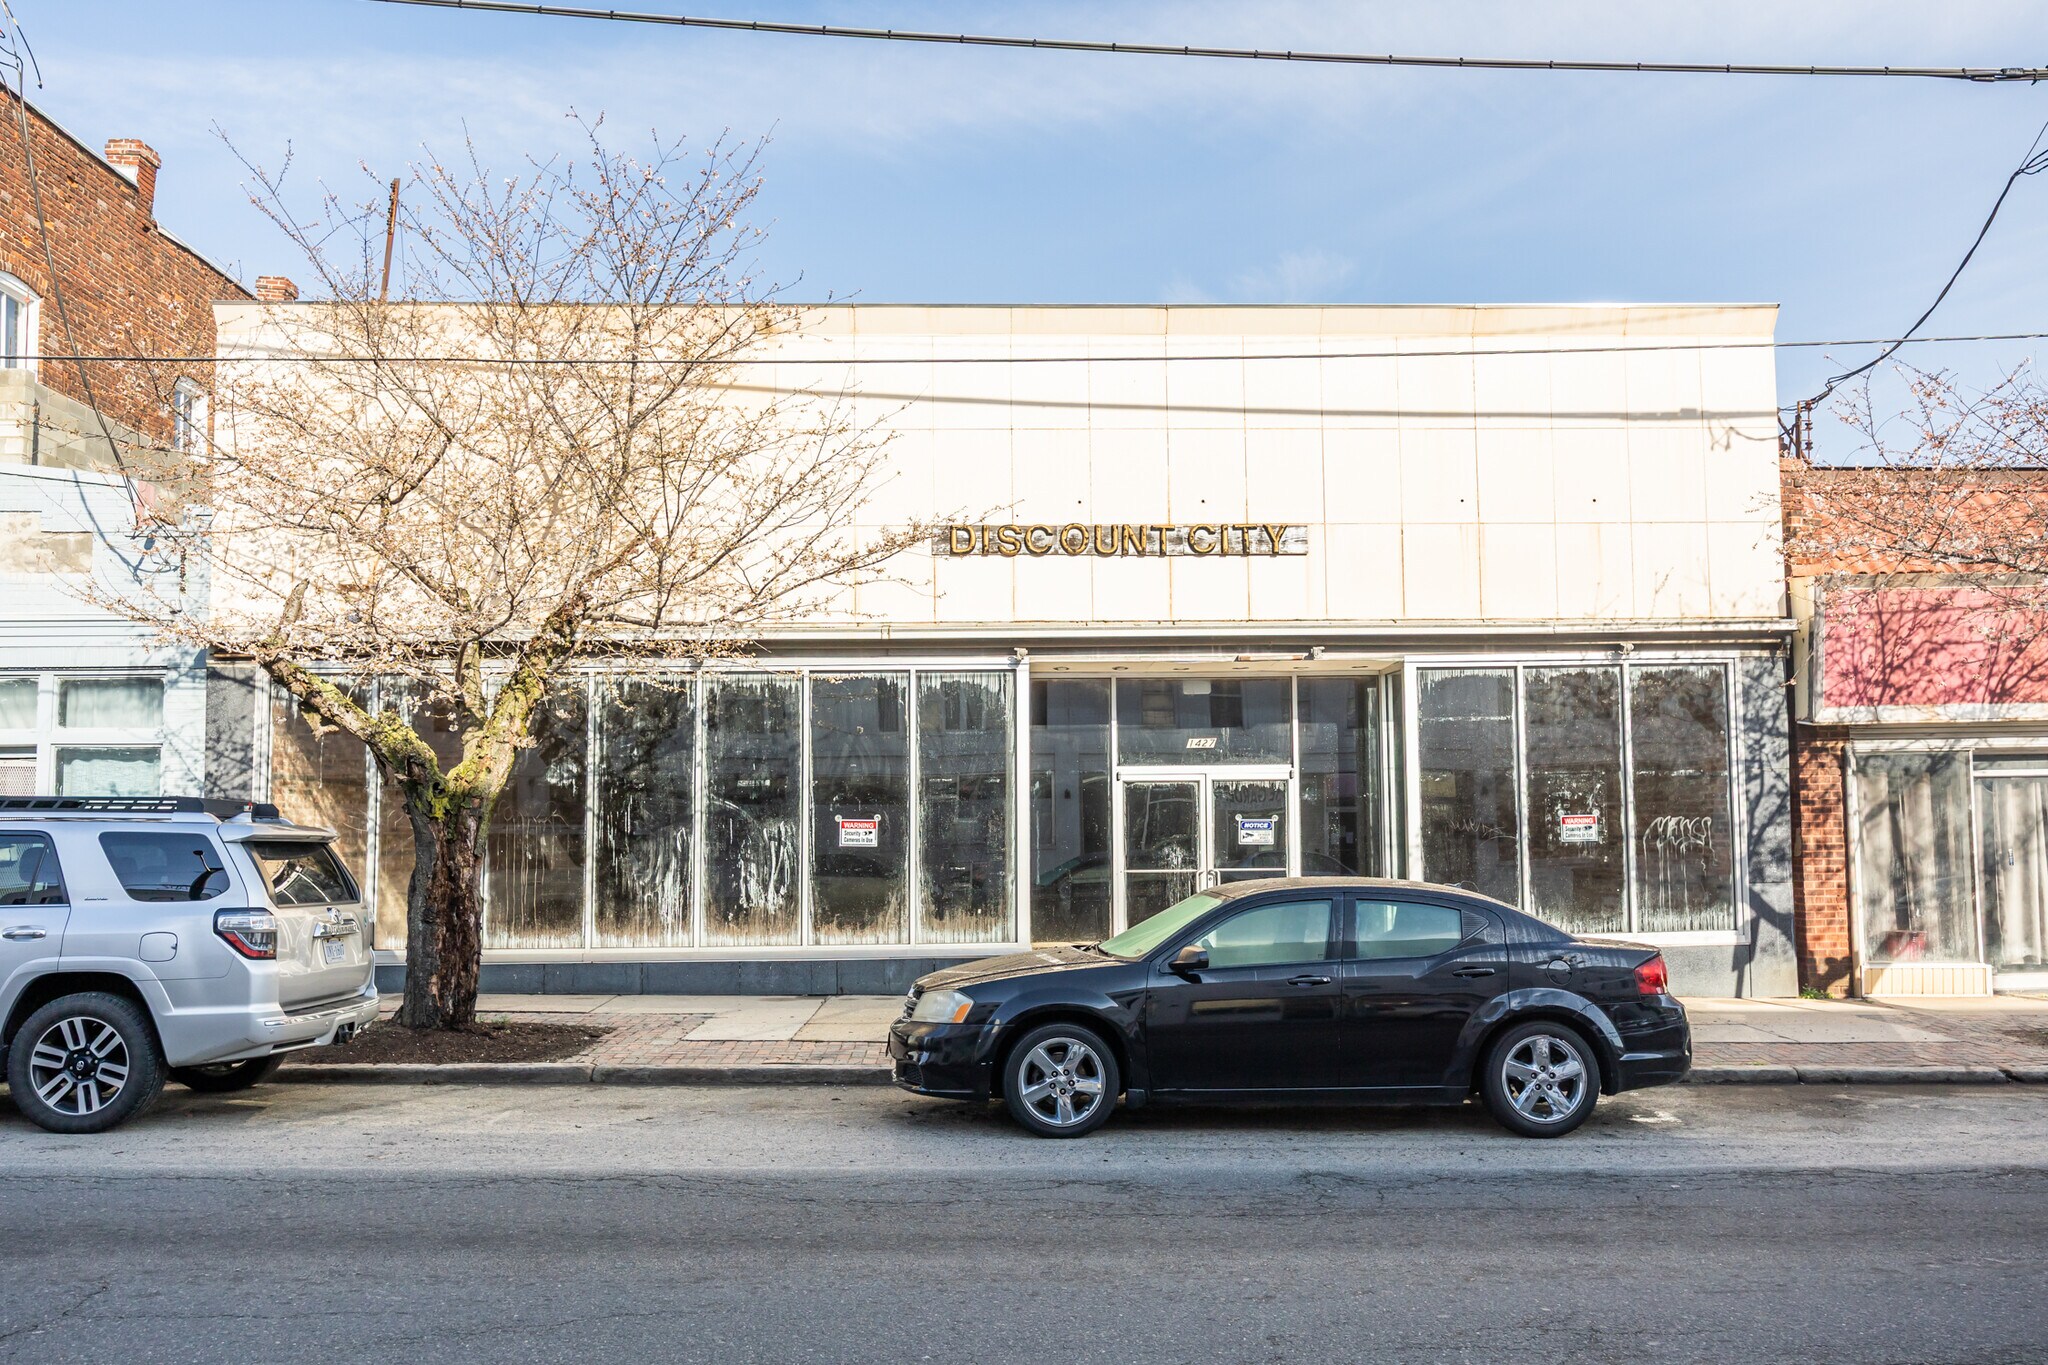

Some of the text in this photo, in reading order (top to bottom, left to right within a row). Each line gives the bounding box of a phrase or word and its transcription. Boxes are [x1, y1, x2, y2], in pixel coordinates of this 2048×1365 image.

[950, 523, 1289, 557] DISCOUNT CITY
[1189, 739, 1216, 748] 1427
